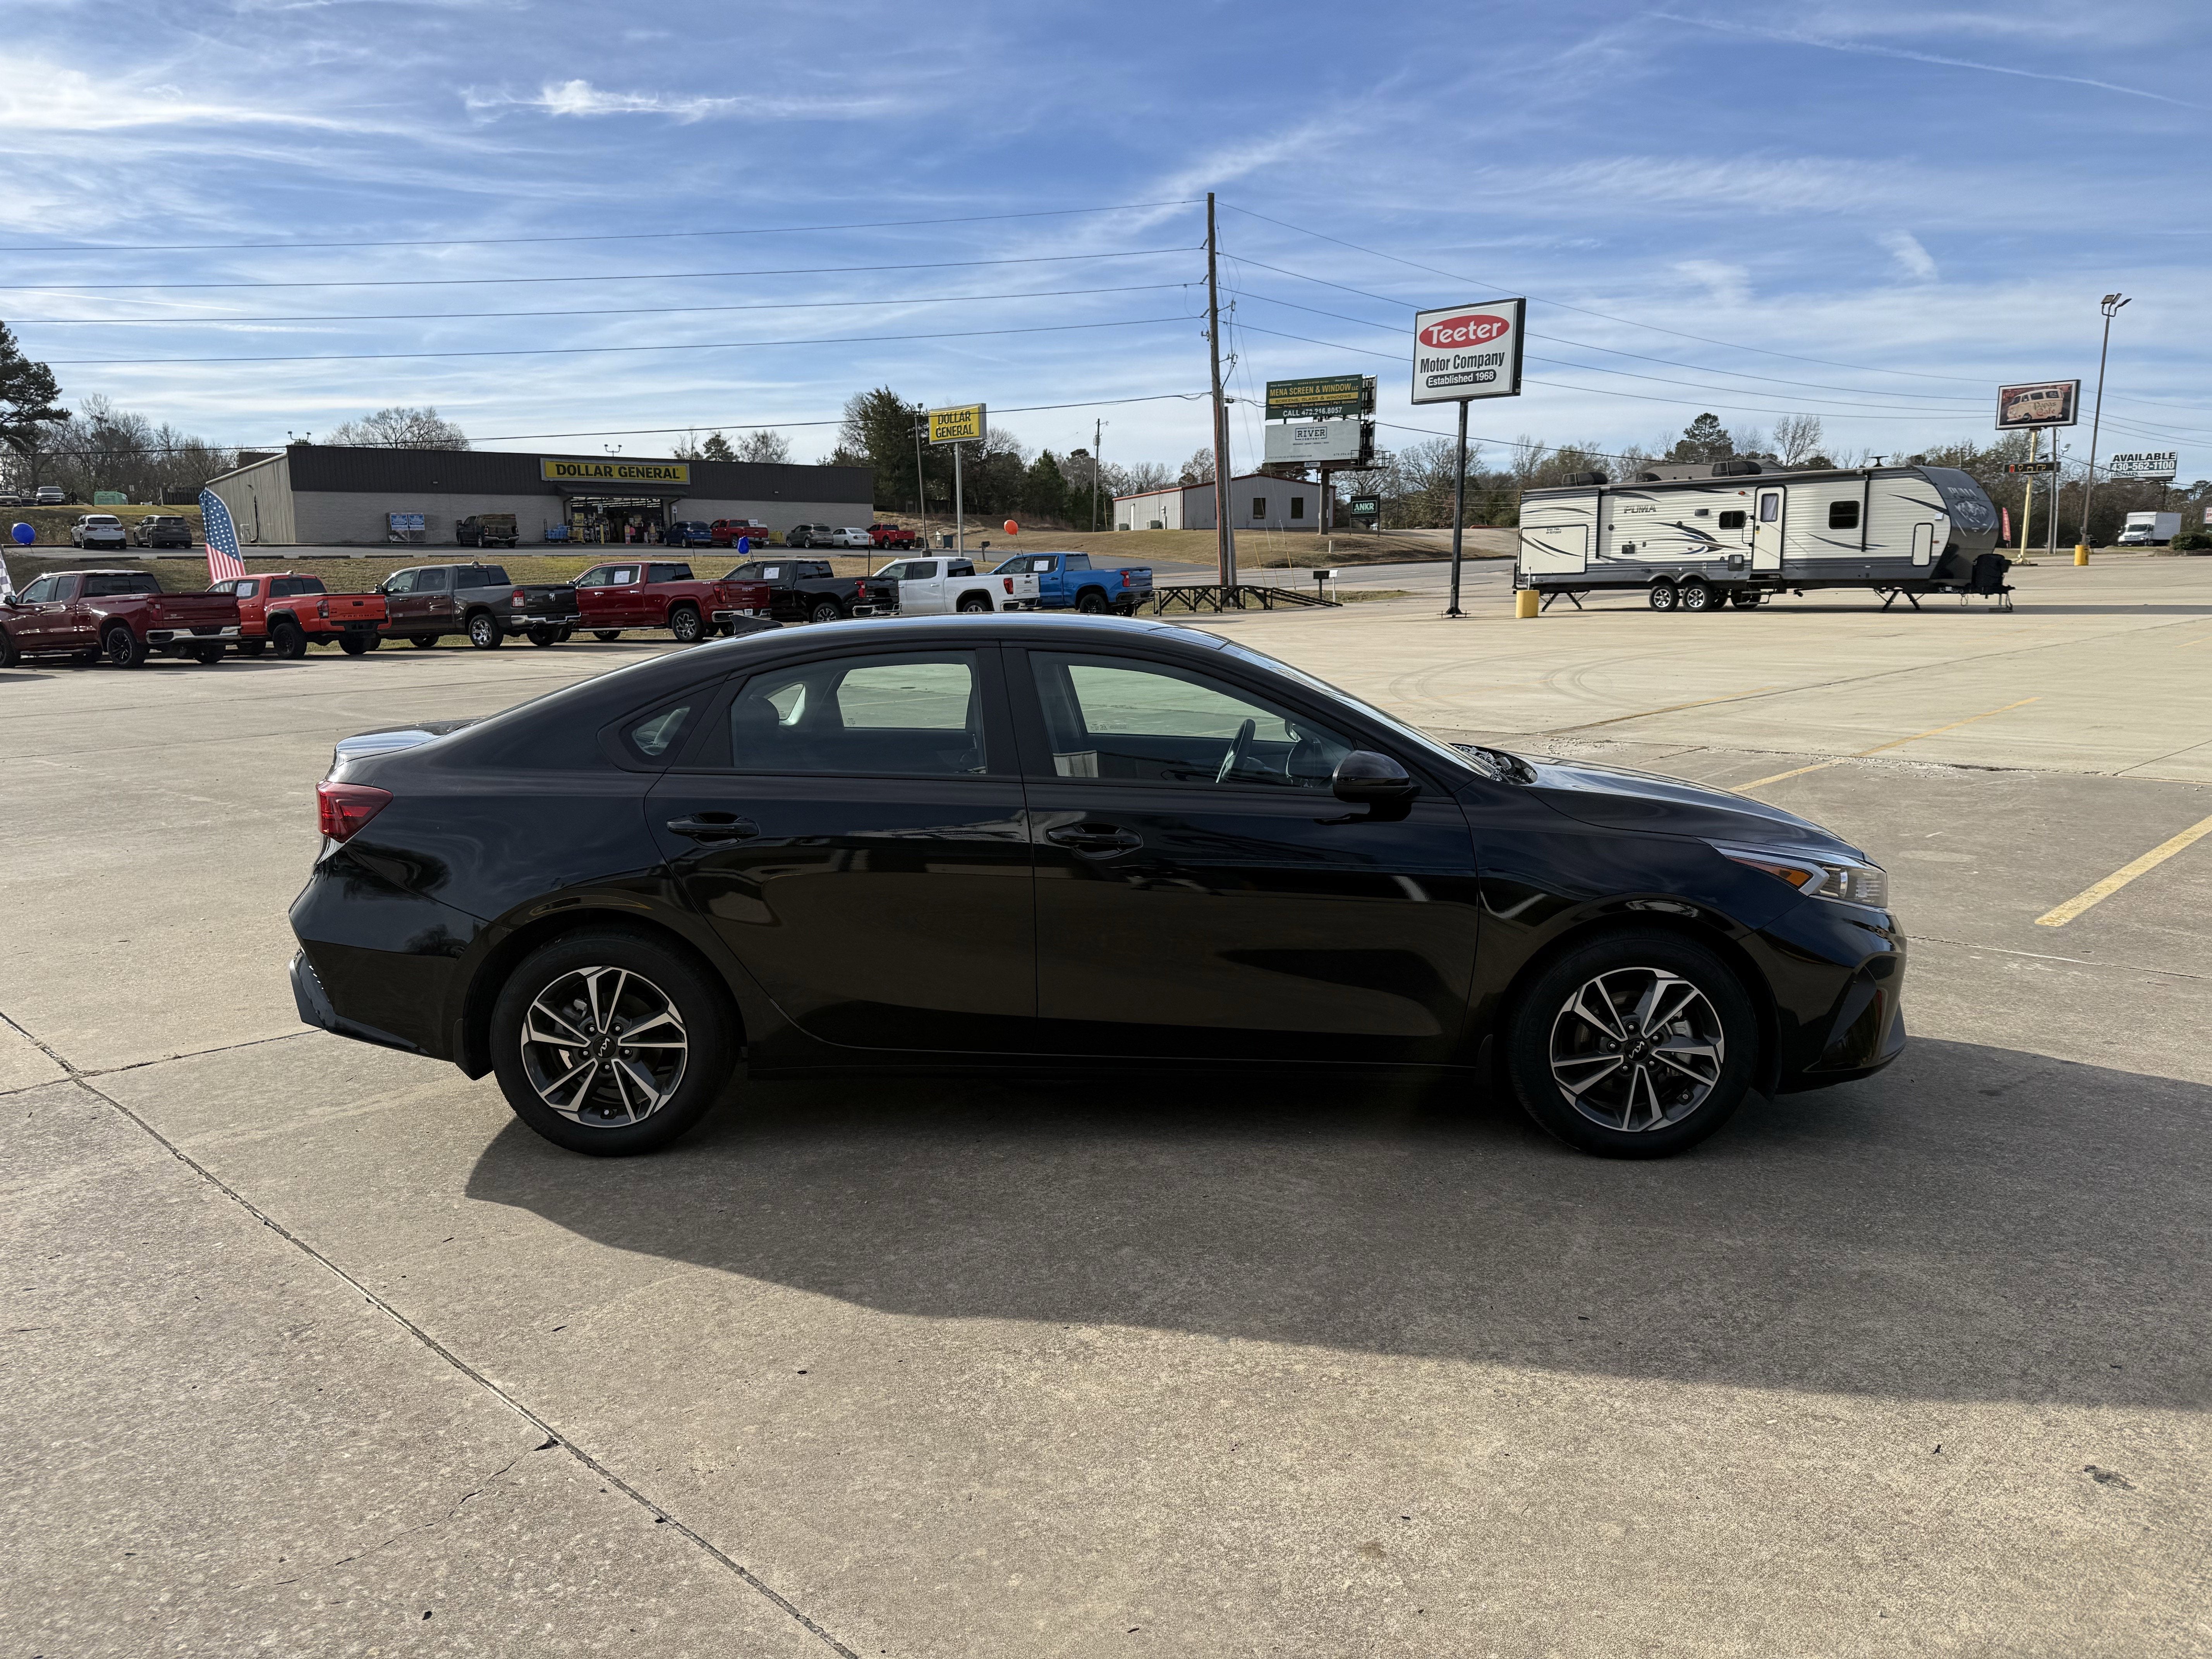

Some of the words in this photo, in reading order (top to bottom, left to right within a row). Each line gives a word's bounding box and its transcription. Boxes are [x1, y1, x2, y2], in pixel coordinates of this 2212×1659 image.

[1429, 321, 1501, 344] Teeter
[1420, 357, 1451, 373] Motor
[1453, 352, 1505, 370] Company
[1428, 373, 1473, 386] Established
[1475, 371, 1494, 381] 1968
[1270, 388, 1288, 397] MENA
[1289, 386, 1313, 395] SCREEN
[1322, 383, 1351, 392] WINDOW
[938, 410, 971, 424] DOLLAR
[936, 423, 974, 438] GENERAL
[1297, 429, 1325, 437] RIVER
[2112, 452, 2176, 462] AVAILABLE
[555, 464, 613, 477] DOLLAR
[618, 466, 680, 479] GENERAL
[2111, 461, 2174, 471] 430-562-1100
[1947, 487, 1979, 500] PUMA
[1624, 505, 1656, 513] PUMA
